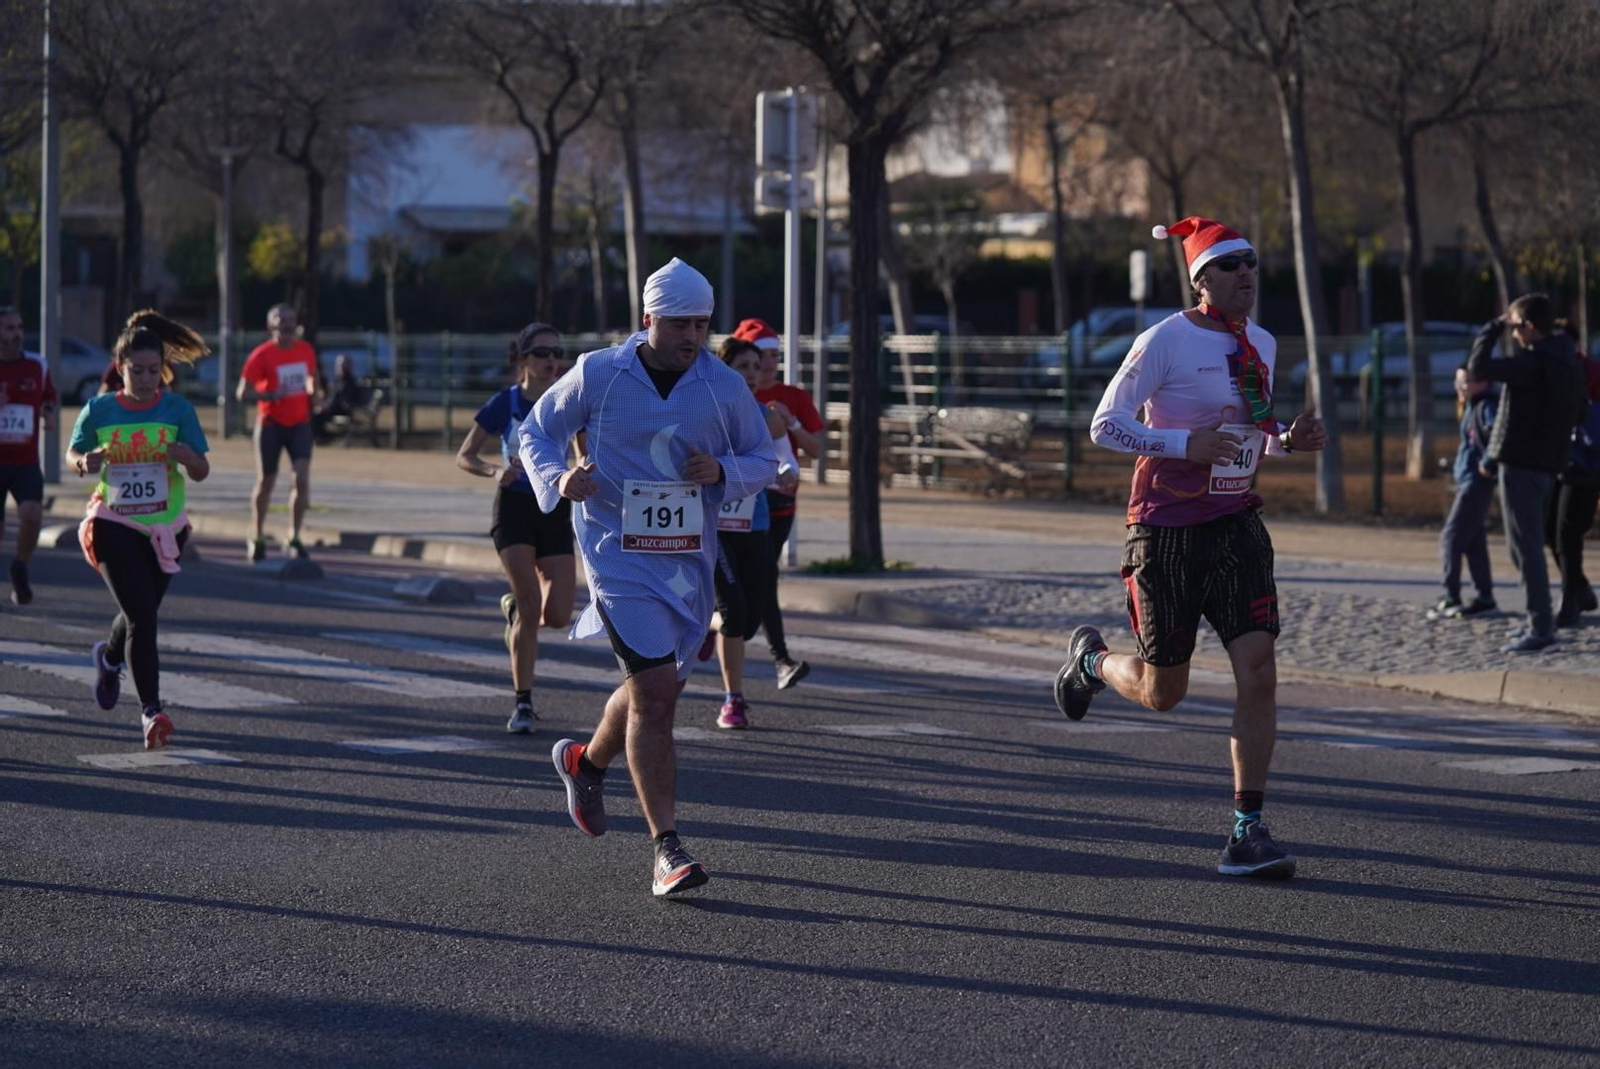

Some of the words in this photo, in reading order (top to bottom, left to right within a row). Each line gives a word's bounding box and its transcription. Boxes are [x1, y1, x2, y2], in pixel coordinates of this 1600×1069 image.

[1099, 420, 1148, 451] IMDECO
[1233, 448, 1253, 470] 40
[121, 481, 156, 499] 205
[722, 499, 744, 514] 87
[642, 506, 684, 529] 191
[628, 535, 688, 550] Cruzcampo
